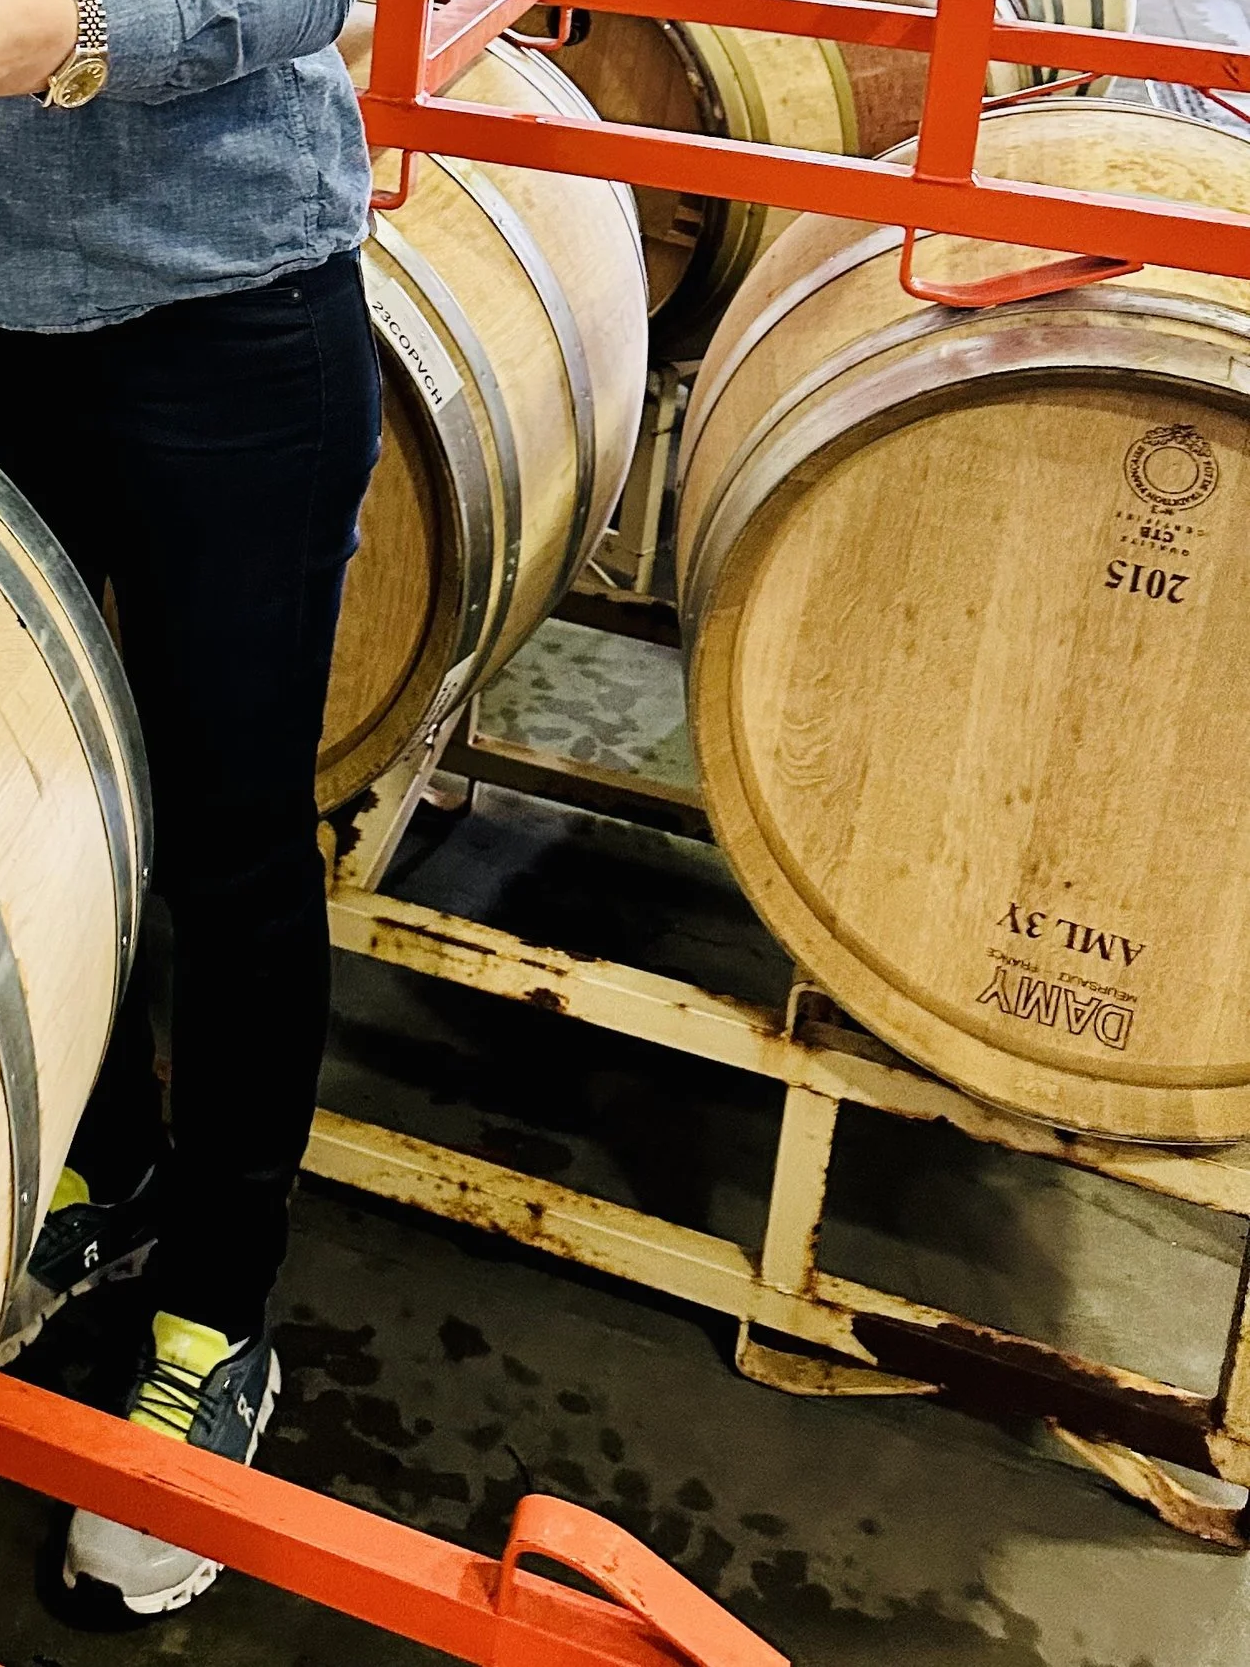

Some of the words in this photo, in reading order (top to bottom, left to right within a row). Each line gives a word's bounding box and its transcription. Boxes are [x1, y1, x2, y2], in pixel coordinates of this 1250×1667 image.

[372, 301, 442, 405] 23COPVCH
[1139, 526, 1174, 543] CTB
[1104, 559, 1190, 604] 2015
[996, 902, 1047, 940] 3Y
[1055, 919, 1146, 967] AML
[986, 947, 1039, 973] FRANCE
[976, 965, 1135, 1051] DAMY
